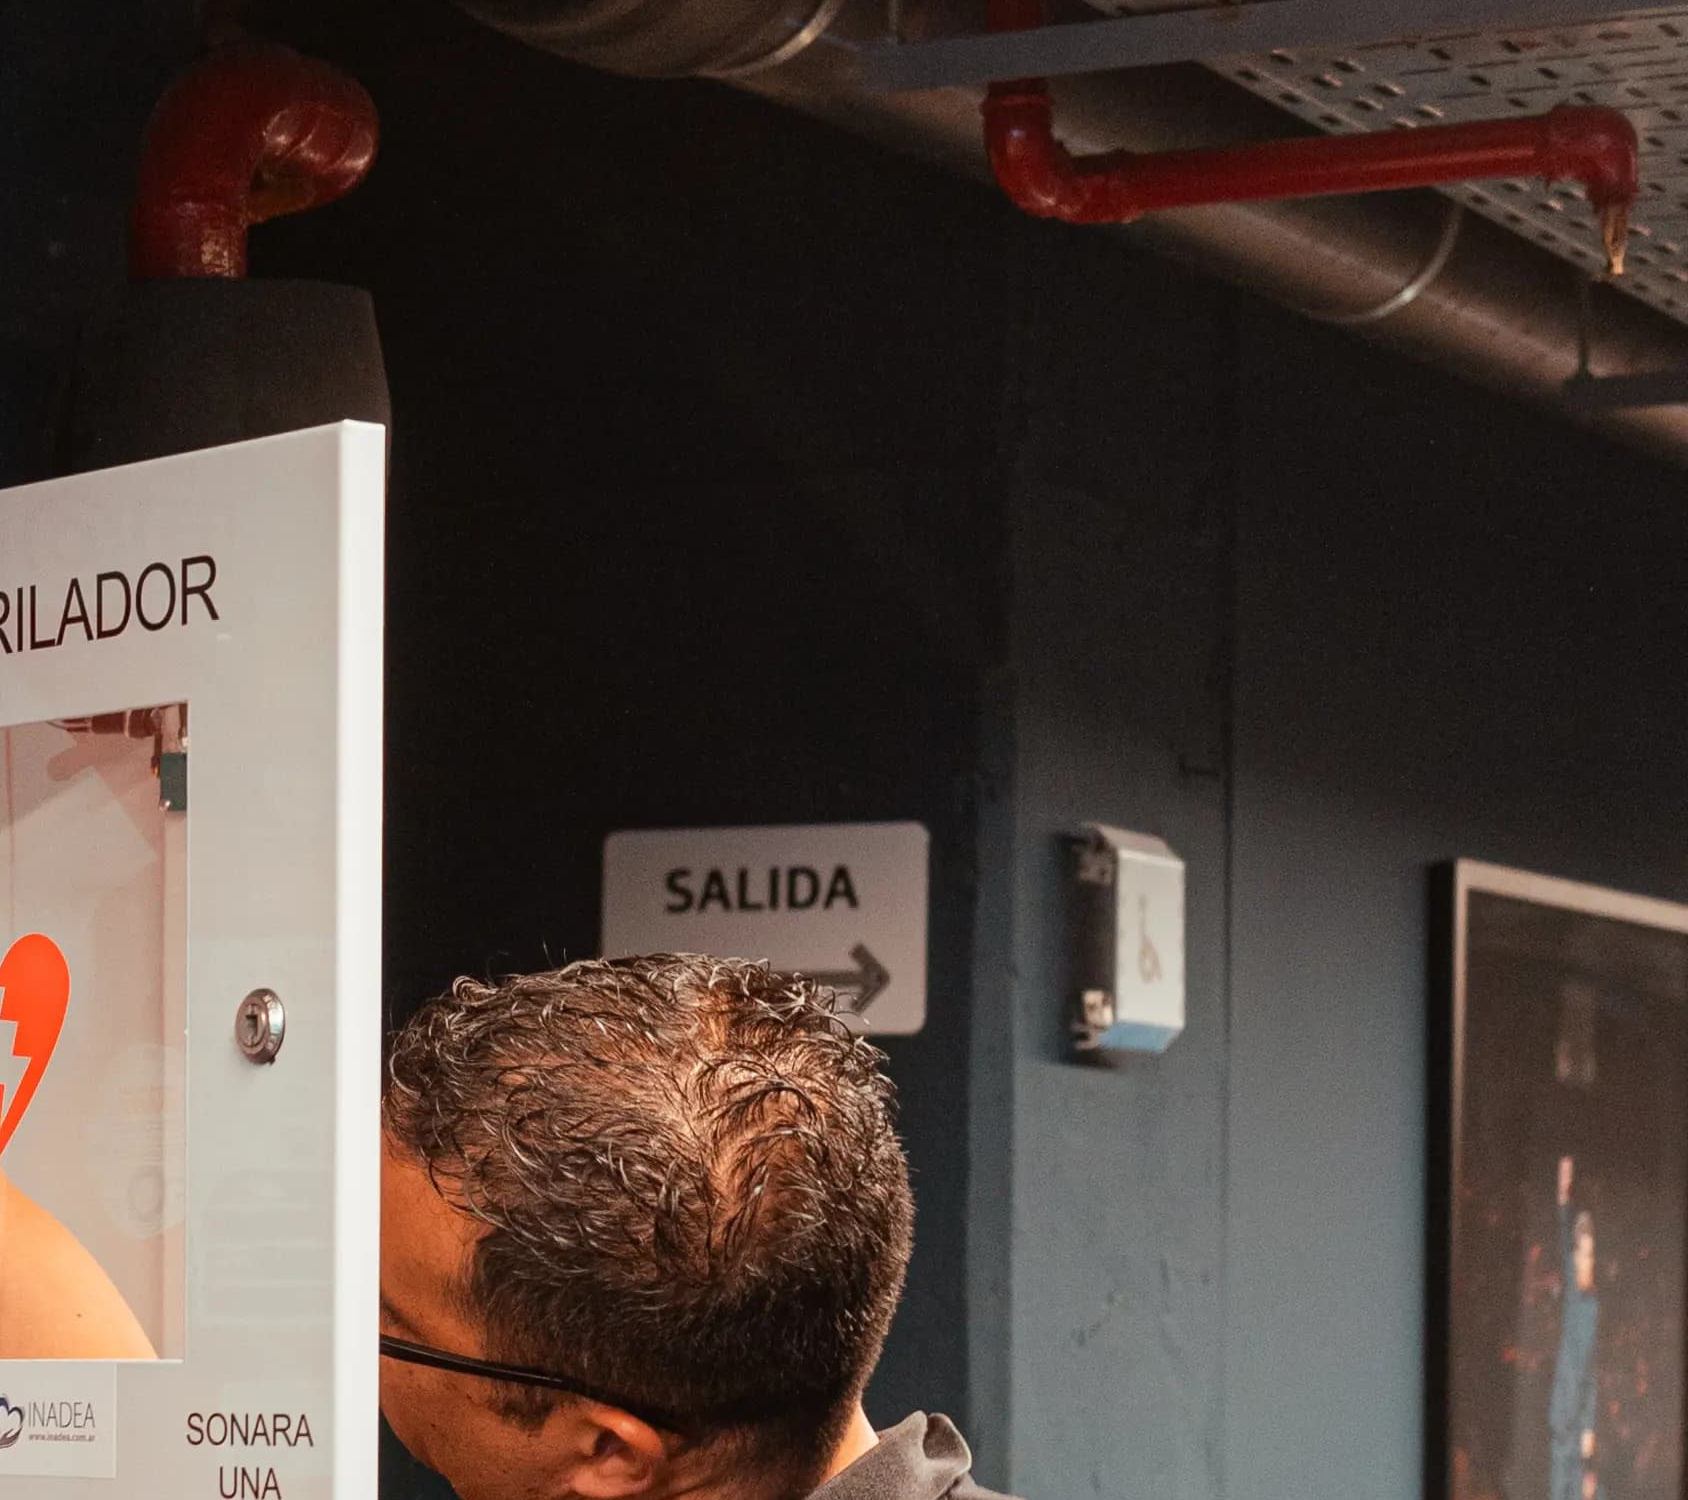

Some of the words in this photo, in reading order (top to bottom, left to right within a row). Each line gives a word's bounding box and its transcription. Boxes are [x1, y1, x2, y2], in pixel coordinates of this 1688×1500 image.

[665, 865, 859, 915] SALIDA
[28, 1402, 96, 1428] INADEA
[186, 1412, 314, 1448] SONARA
[29, 1433, 95, 1443] www.inadea.com.ar
[219, 1466, 281, 1500] UNA
